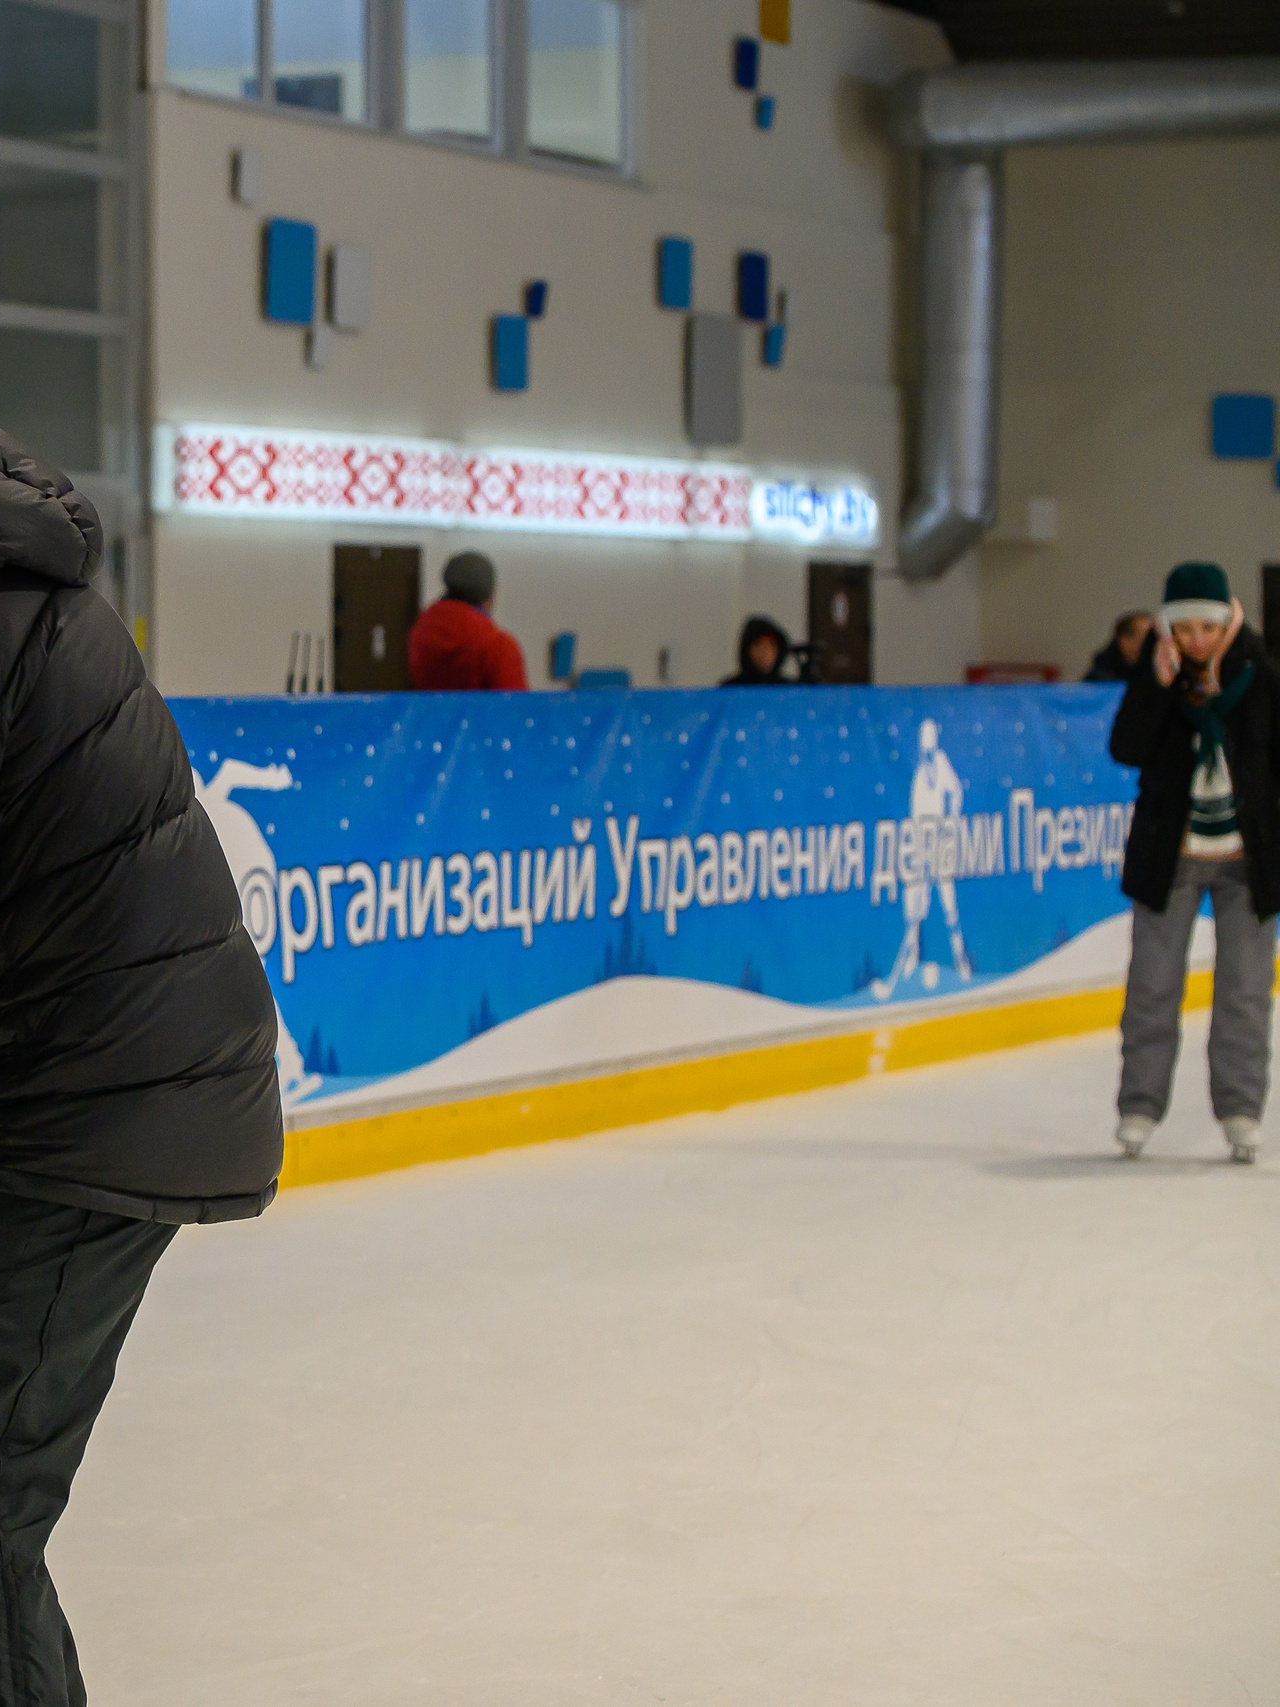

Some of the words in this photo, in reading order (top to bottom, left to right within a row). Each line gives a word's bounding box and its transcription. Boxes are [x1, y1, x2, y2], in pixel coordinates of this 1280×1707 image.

[241, 816, 596, 985] организаций
[605, 813, 865, 937] Управления
[871, 811, 1006, 907] делами
